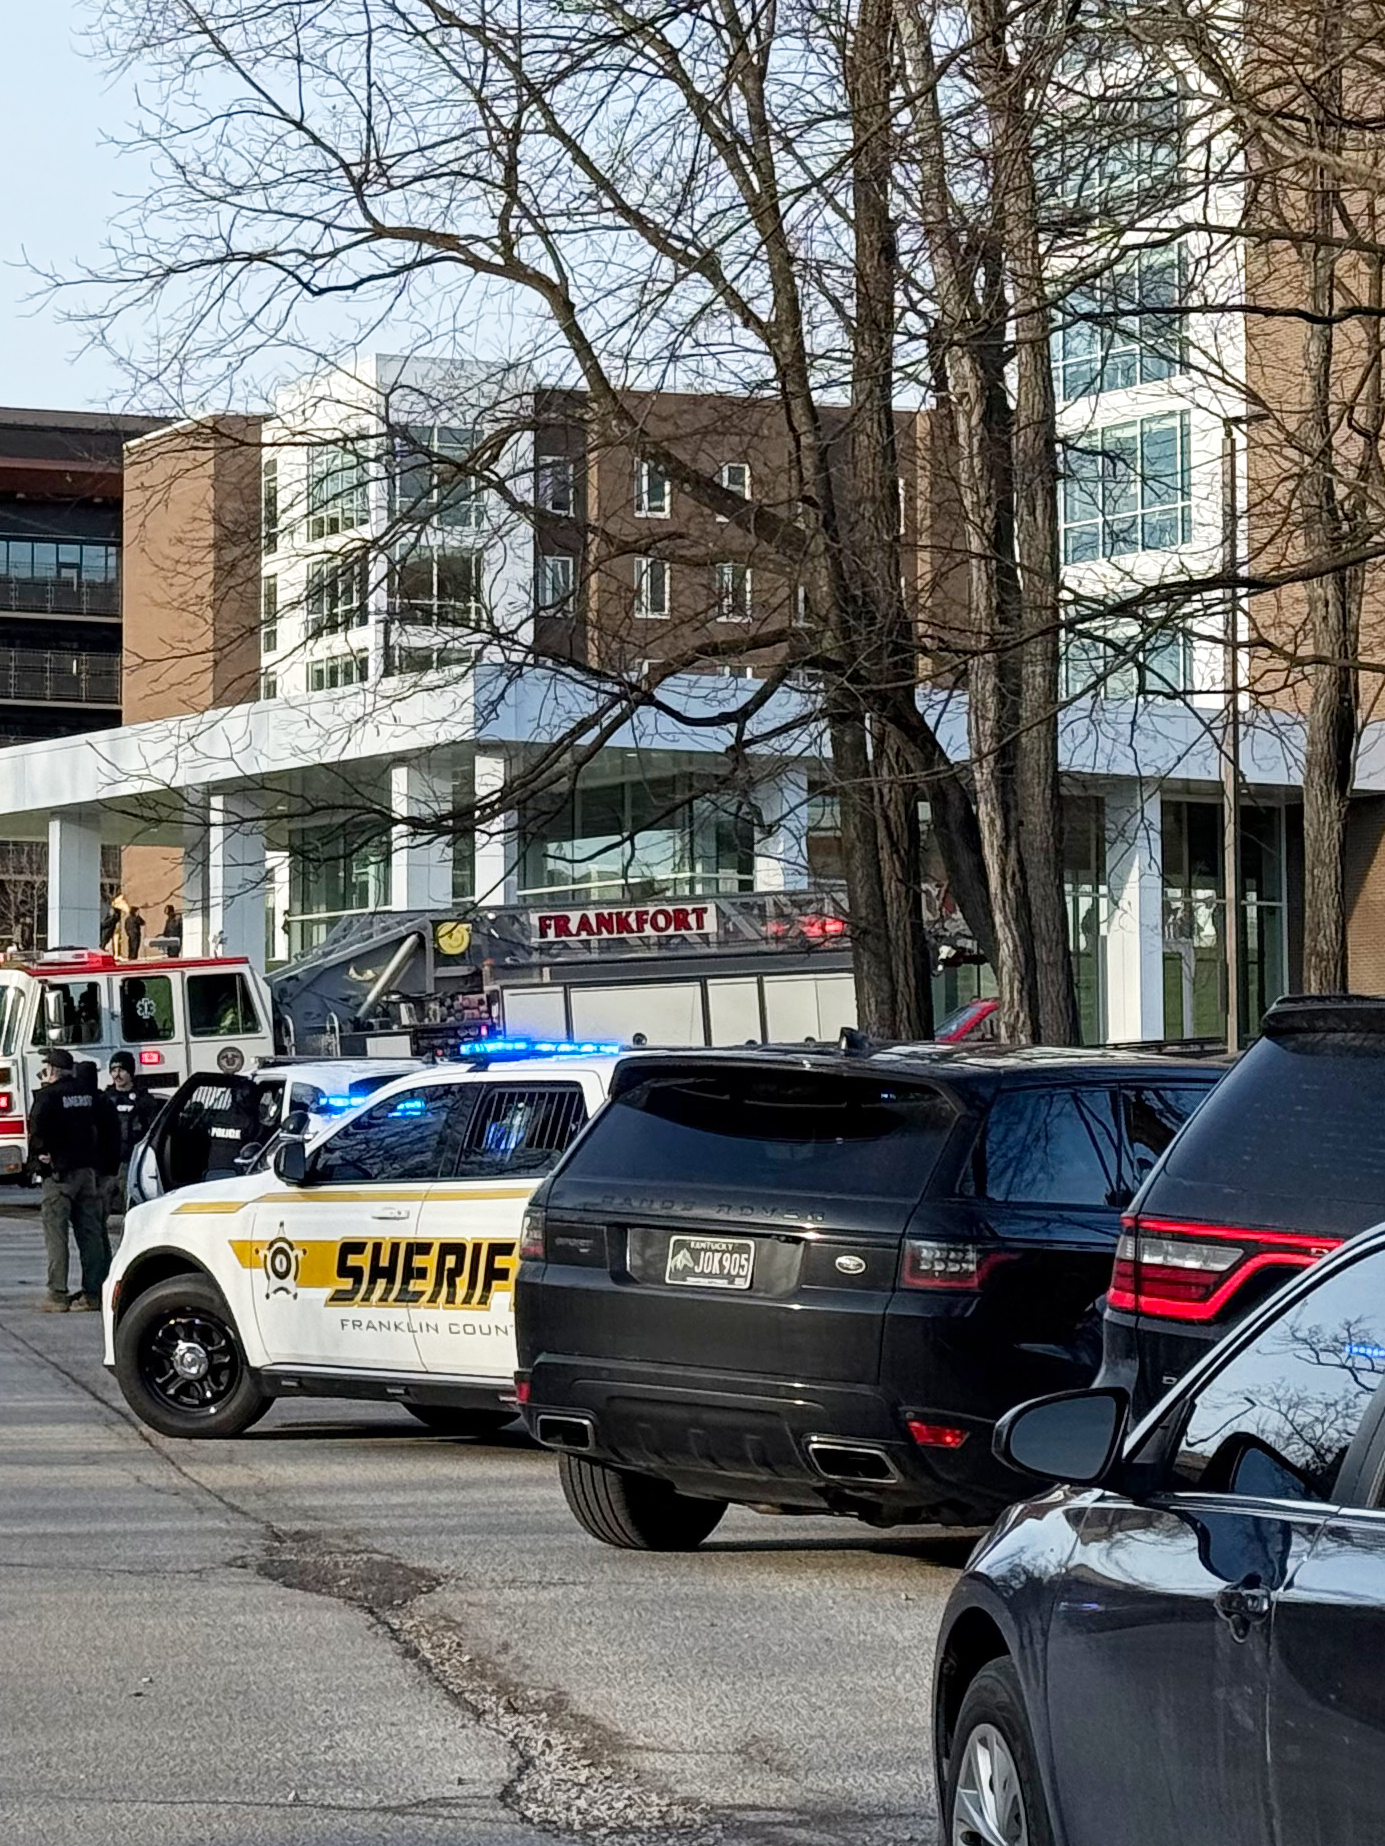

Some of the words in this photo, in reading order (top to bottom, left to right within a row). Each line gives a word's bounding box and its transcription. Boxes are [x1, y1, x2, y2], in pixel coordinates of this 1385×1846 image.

[538, 907, 708, 939] FRANKFORT
[211, 1127, 242, 1139] POLICE
[690, 1241, 734, 1251] KENTUCKY
[326, 1240, 517, 1307] SHERIF
[340, 1318, 439, 1335] FRANKLIN
[448, 1321, 515, 1337] COUN
